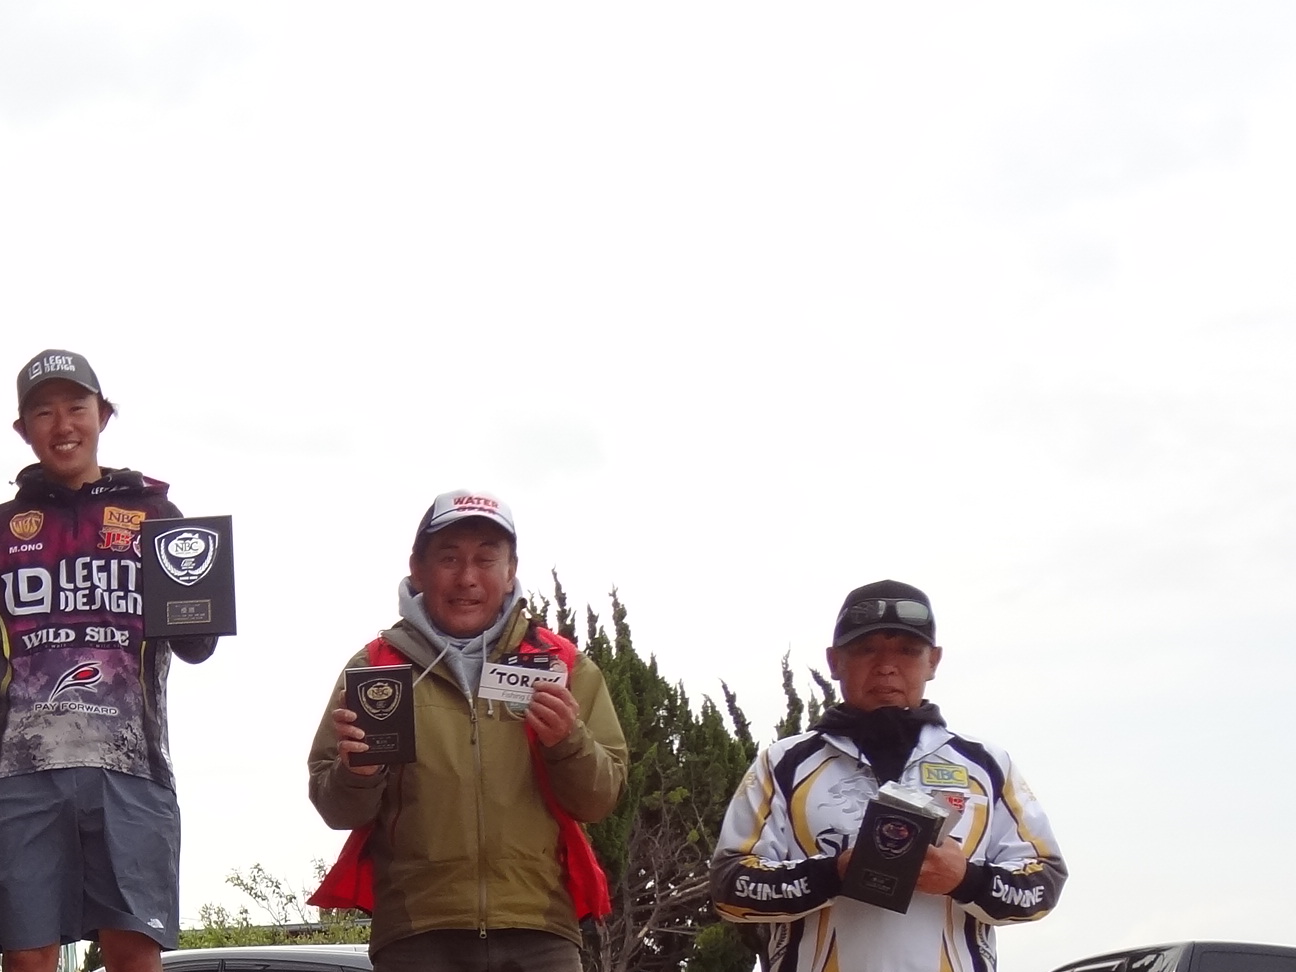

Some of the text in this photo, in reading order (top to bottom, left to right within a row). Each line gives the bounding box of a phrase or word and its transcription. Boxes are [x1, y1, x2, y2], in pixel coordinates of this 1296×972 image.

[43, 355, 73, 366] LEGIT
[453, 496, 499, 508] WATER
[108, 510, 141, 526] NBC
[8, 542, 44, 554] M.ONO
[174, 541, 200, 553] NBC
[59, 556, 142, 591] LEGIT
[59, 587, 143, 616] DESIGN
[21, 626, 130, 651] WILD SIDE
[34, 701, 119, 716] PAY FORWARD
[925, 767, 964, 782] NBC
[735, 875, 811, 901] SUNLINE
